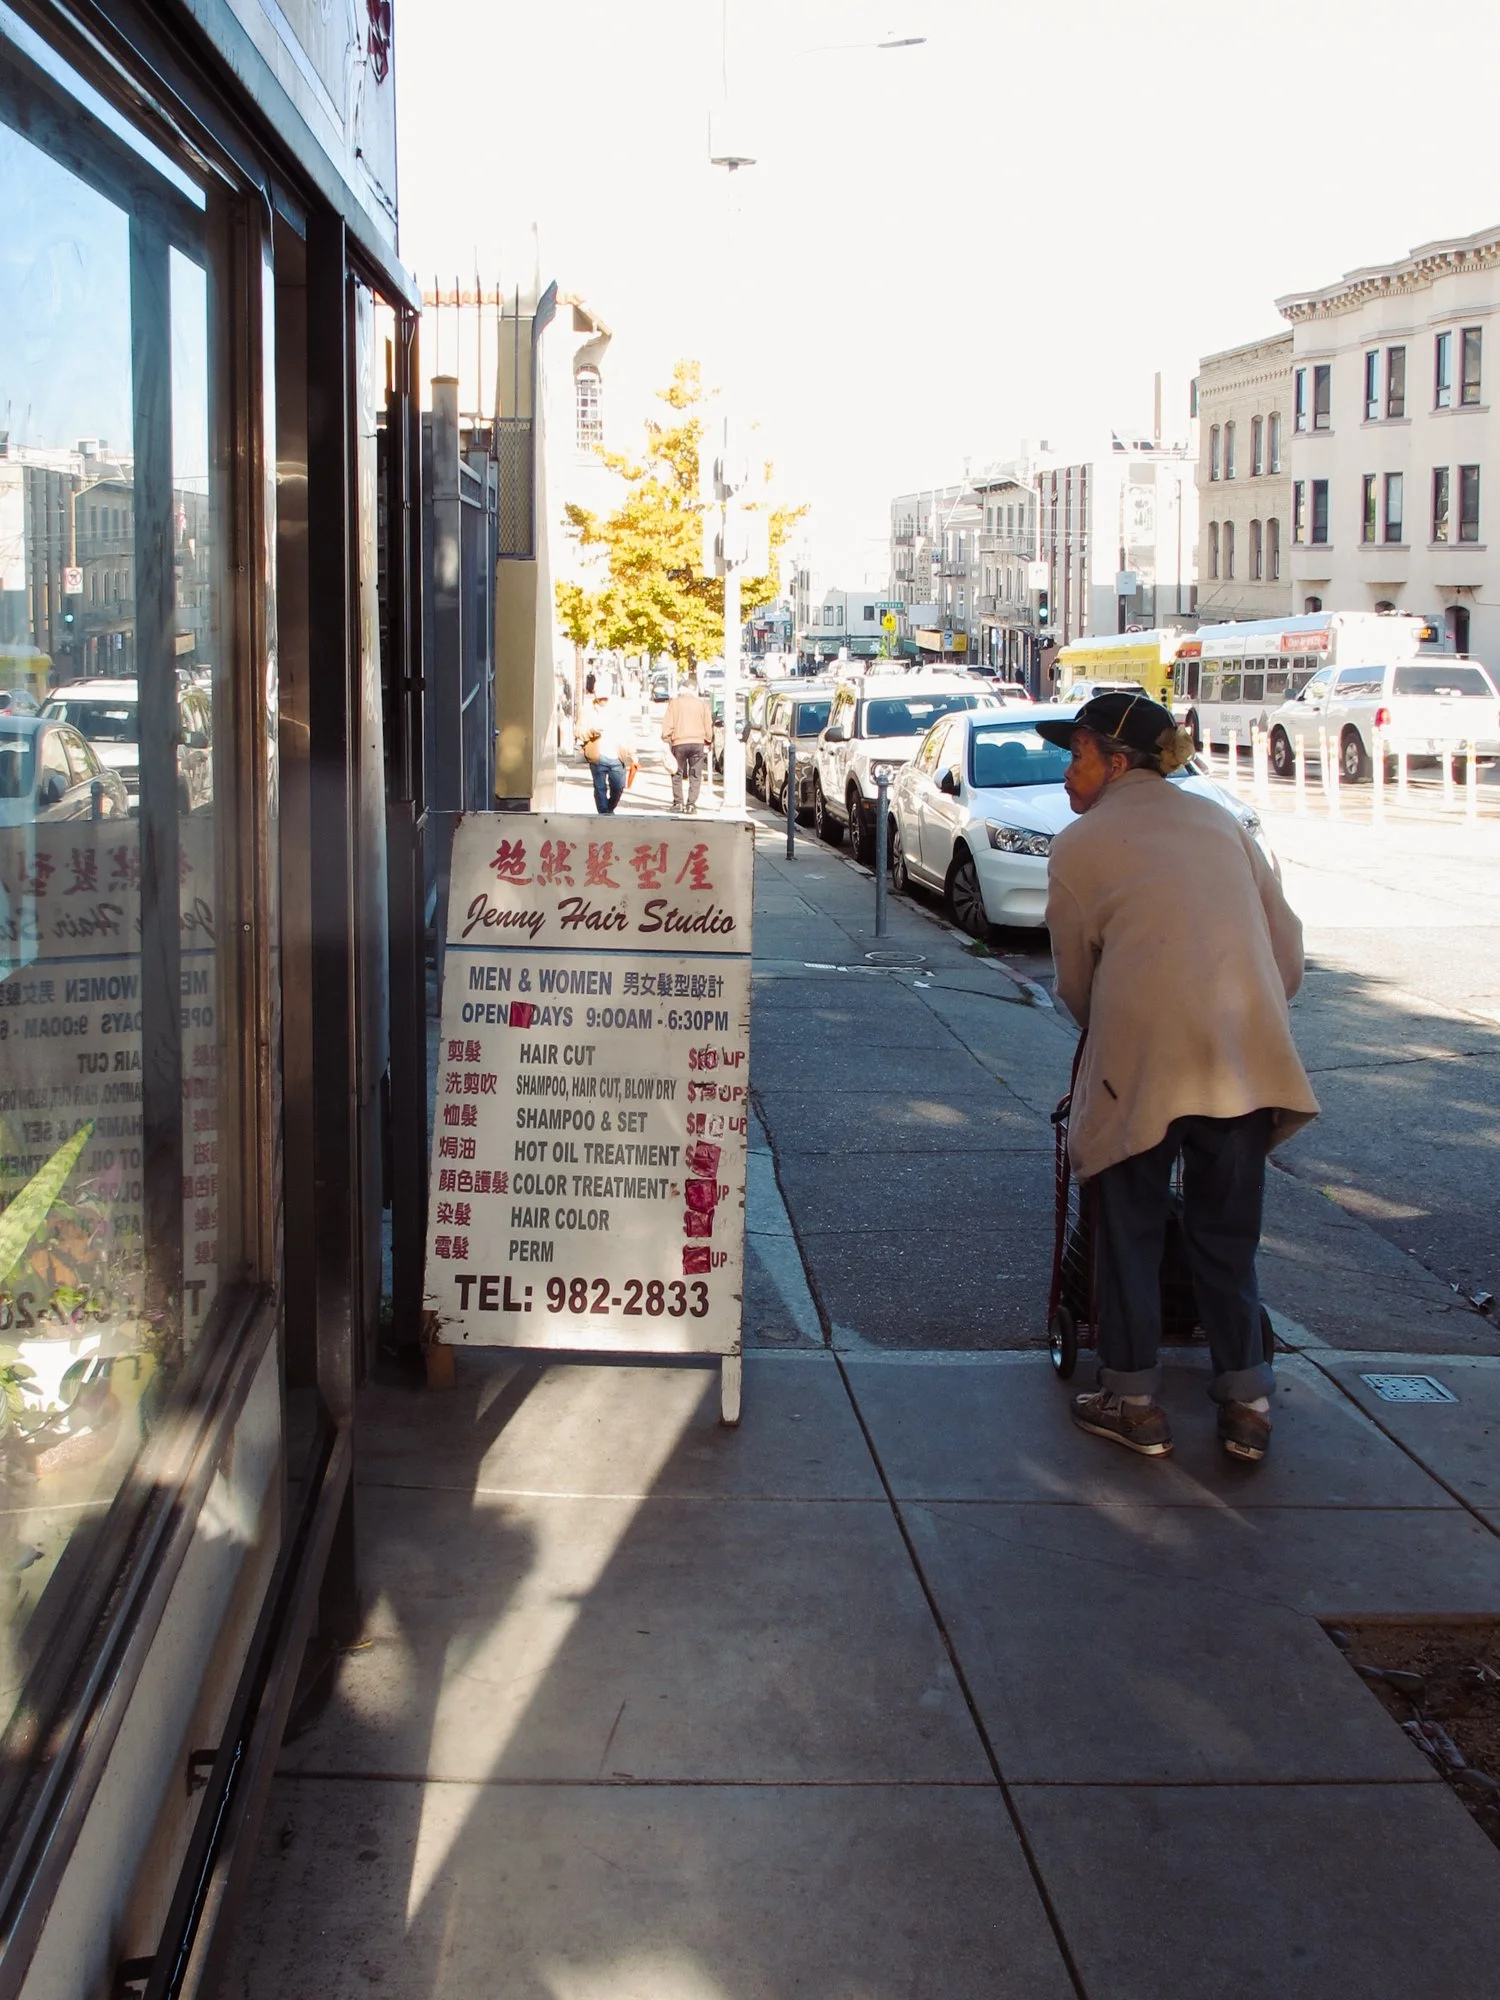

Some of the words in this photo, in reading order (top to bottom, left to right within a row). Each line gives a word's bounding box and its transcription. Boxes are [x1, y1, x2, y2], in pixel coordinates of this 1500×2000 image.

[462, 894, 545, 939] Jenny
[558, 896, 629, 932] Hair
[638, 899, 736, 934] Studio
[469, 966, 511, 991] MEN
[518, 969, 532, 992] &
[539, 969, 612, 995] WOMEN
[623, 973, 724, 998] 男女髮型設計
[462, 1003, 509, 1024] OPEN
[532, 1006, 573, 1027] DAYS
[586, 1008, 652, 1029] 9:00AM
[668, 1011, 728, 1031] 6:30PM
[447, 1040, 481, 1063] 剪髮
[520, 1044, 558, 1064] HAIR
[563, 1046, 596, 1065] CUT
[445, 1073, 497, 1094] 洗剪吹
[516, 1074, 568, 1099] SHAMPOO,
[572, 1077, 596, 1098] HAIR
[600, 1078, 621, 1102] CUT,
[625, 1078, 654, 1099] BLOW
[656, 1079, 676, 1100] DRY
[516, 1108, 595, 1131] SHAMPOO
[601, 1110, 611, 1131] &
[617, 1112, 647, 1133] SET
[439, 1137, 476, 1159] 焗油
[514, 1141, 547, 1162] HOT
[553, 1142, 578, 1164] OIL
[584, 1143, 680, 1167] TREATMENT
[513, 1174, 566, 1196] COLOR
[572, 1176, 669, 1200] TREATMENT
[437, 1202, 471, 1226] 染髮
[511, 1206, 550, 1228] HAIR
[555, 1208, 609, 1230] COLOR
[435, 1236, 469, 1259] 電髮
[509, 1240, 553, 1262] PERM
[711, 1252, 727, 1268] UP
[455, 1274, 532, 1312] TEL:
[546, 1277, 709, 1318] 982-2833
